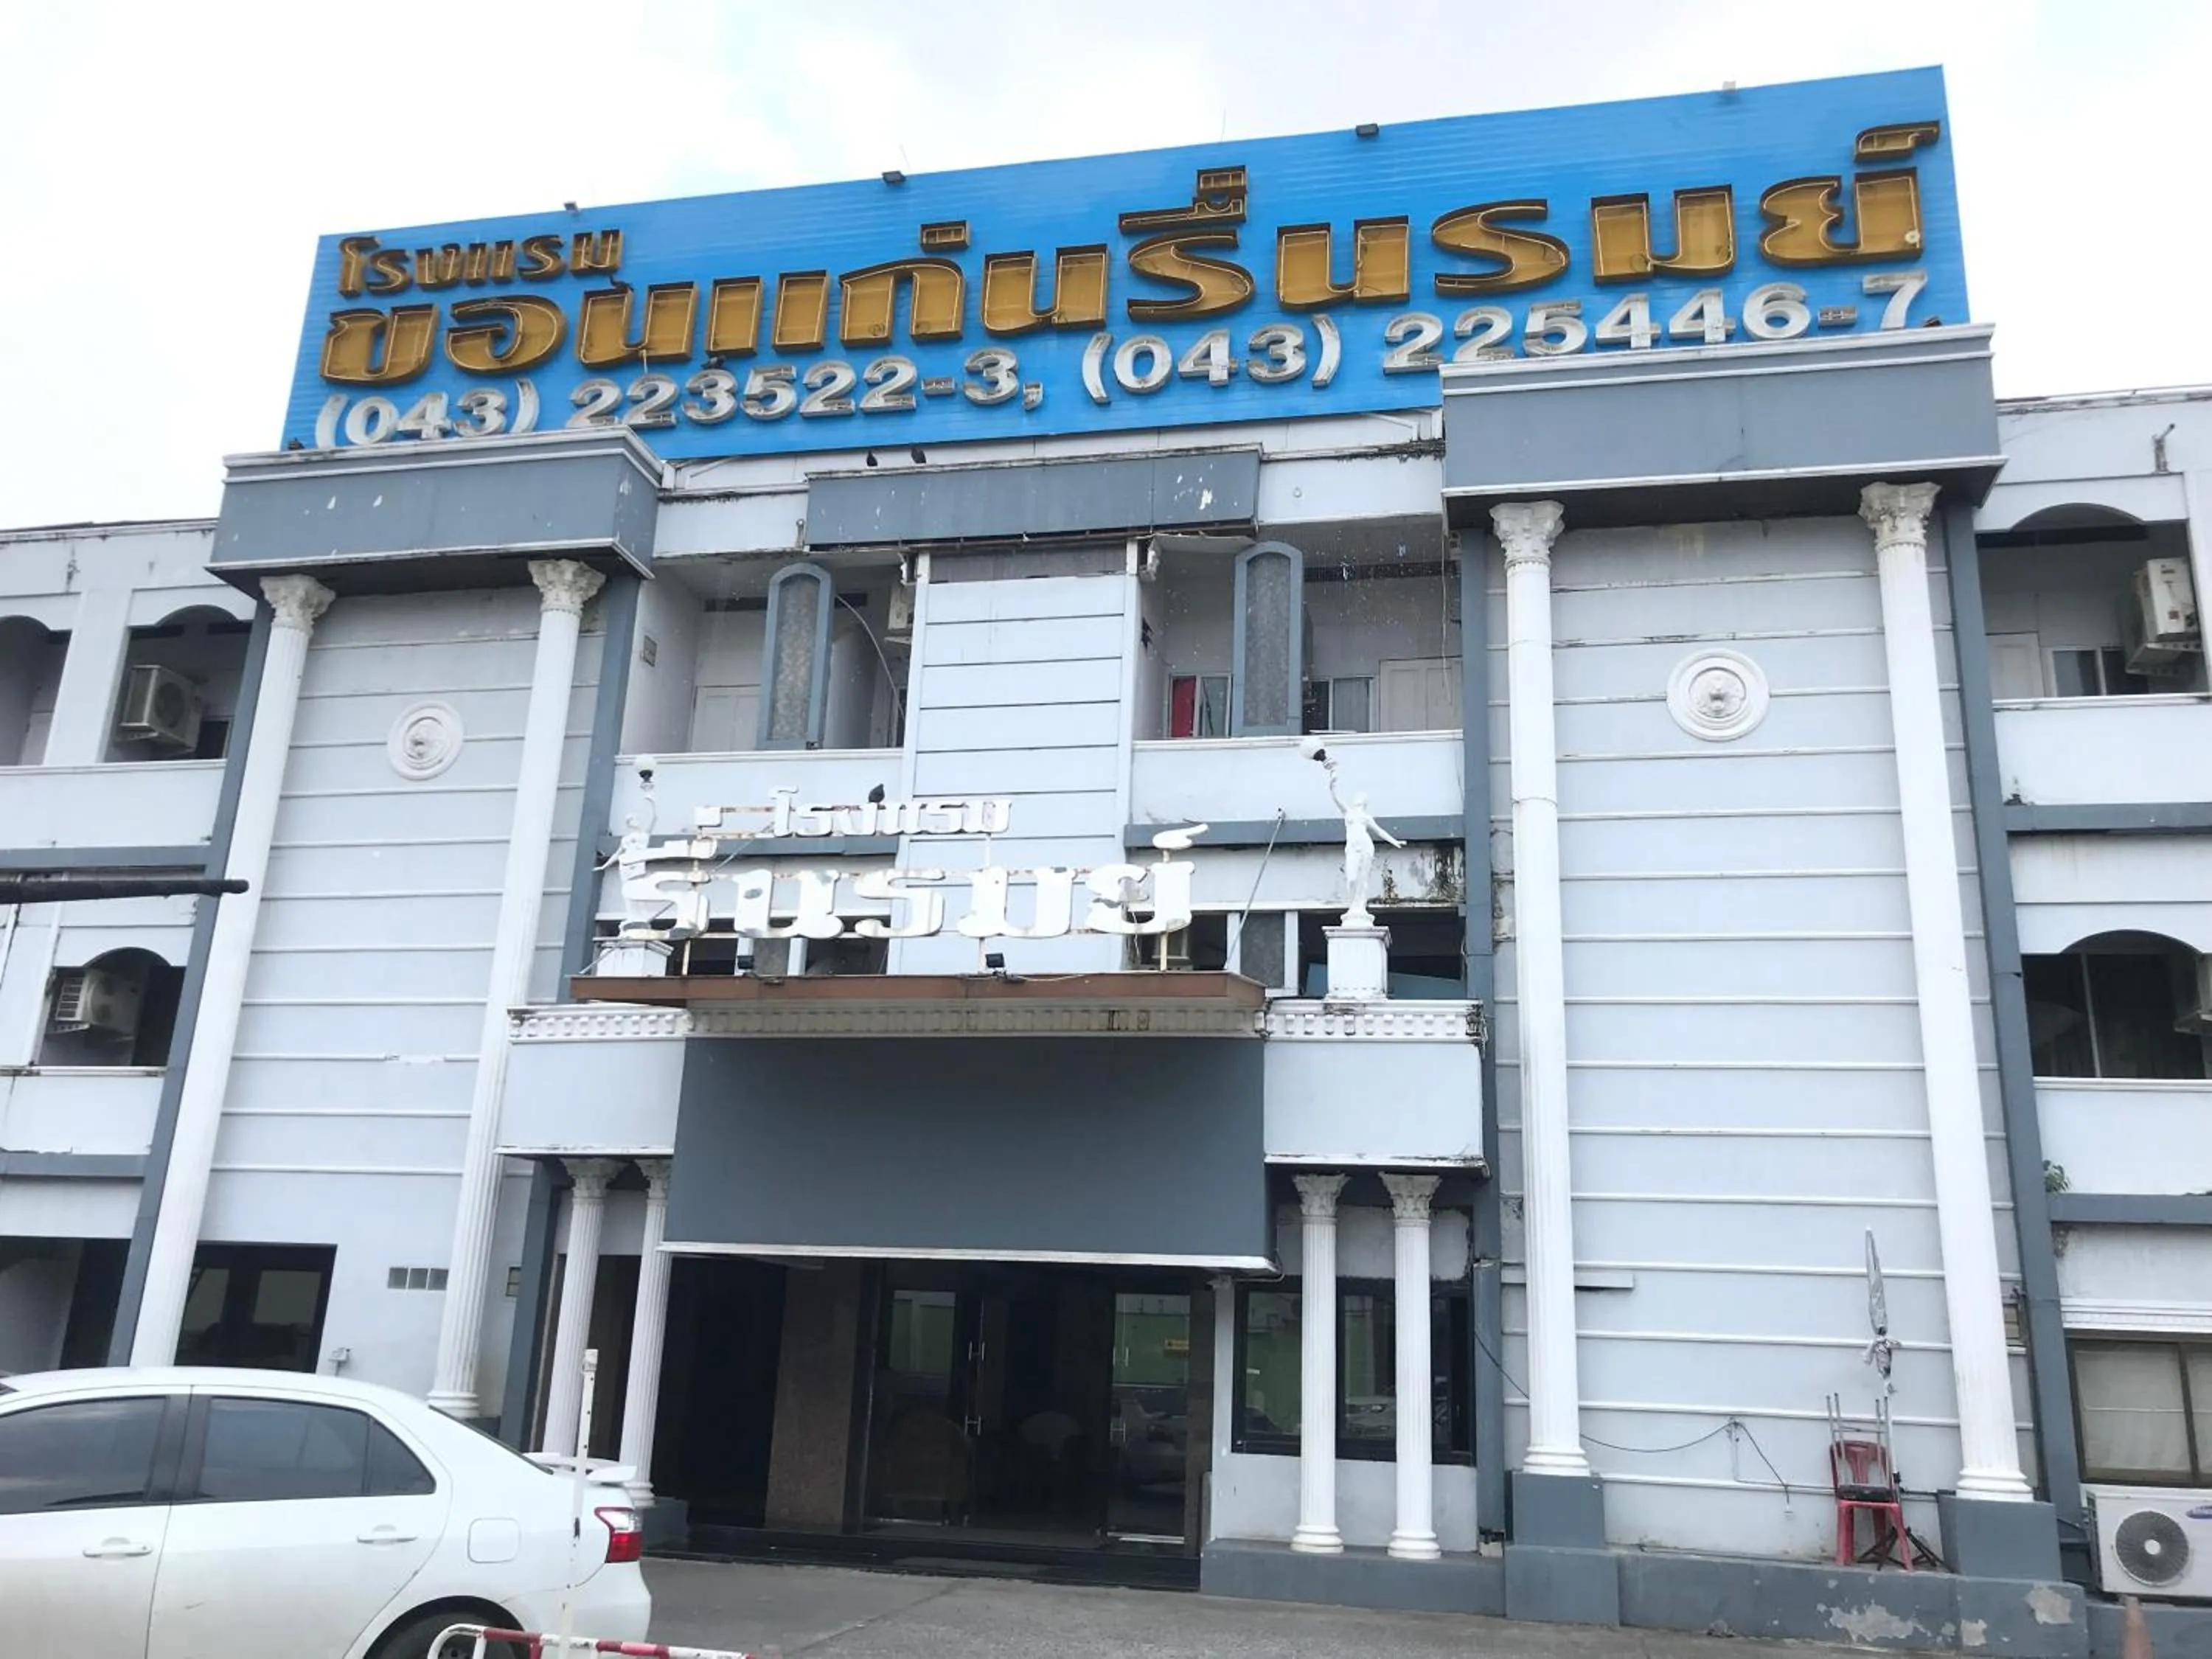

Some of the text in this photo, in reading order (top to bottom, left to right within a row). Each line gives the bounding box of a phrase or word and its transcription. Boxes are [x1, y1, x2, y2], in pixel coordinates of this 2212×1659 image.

[339, 229, 624, 296] โรงแรม
[315, 268, 1928, 450] (043) 223522-3, (043) 225446-7
[768, 786, 1012, 838] โรงแรม
[618, 807, 1209, 939] รื่นรมย์
